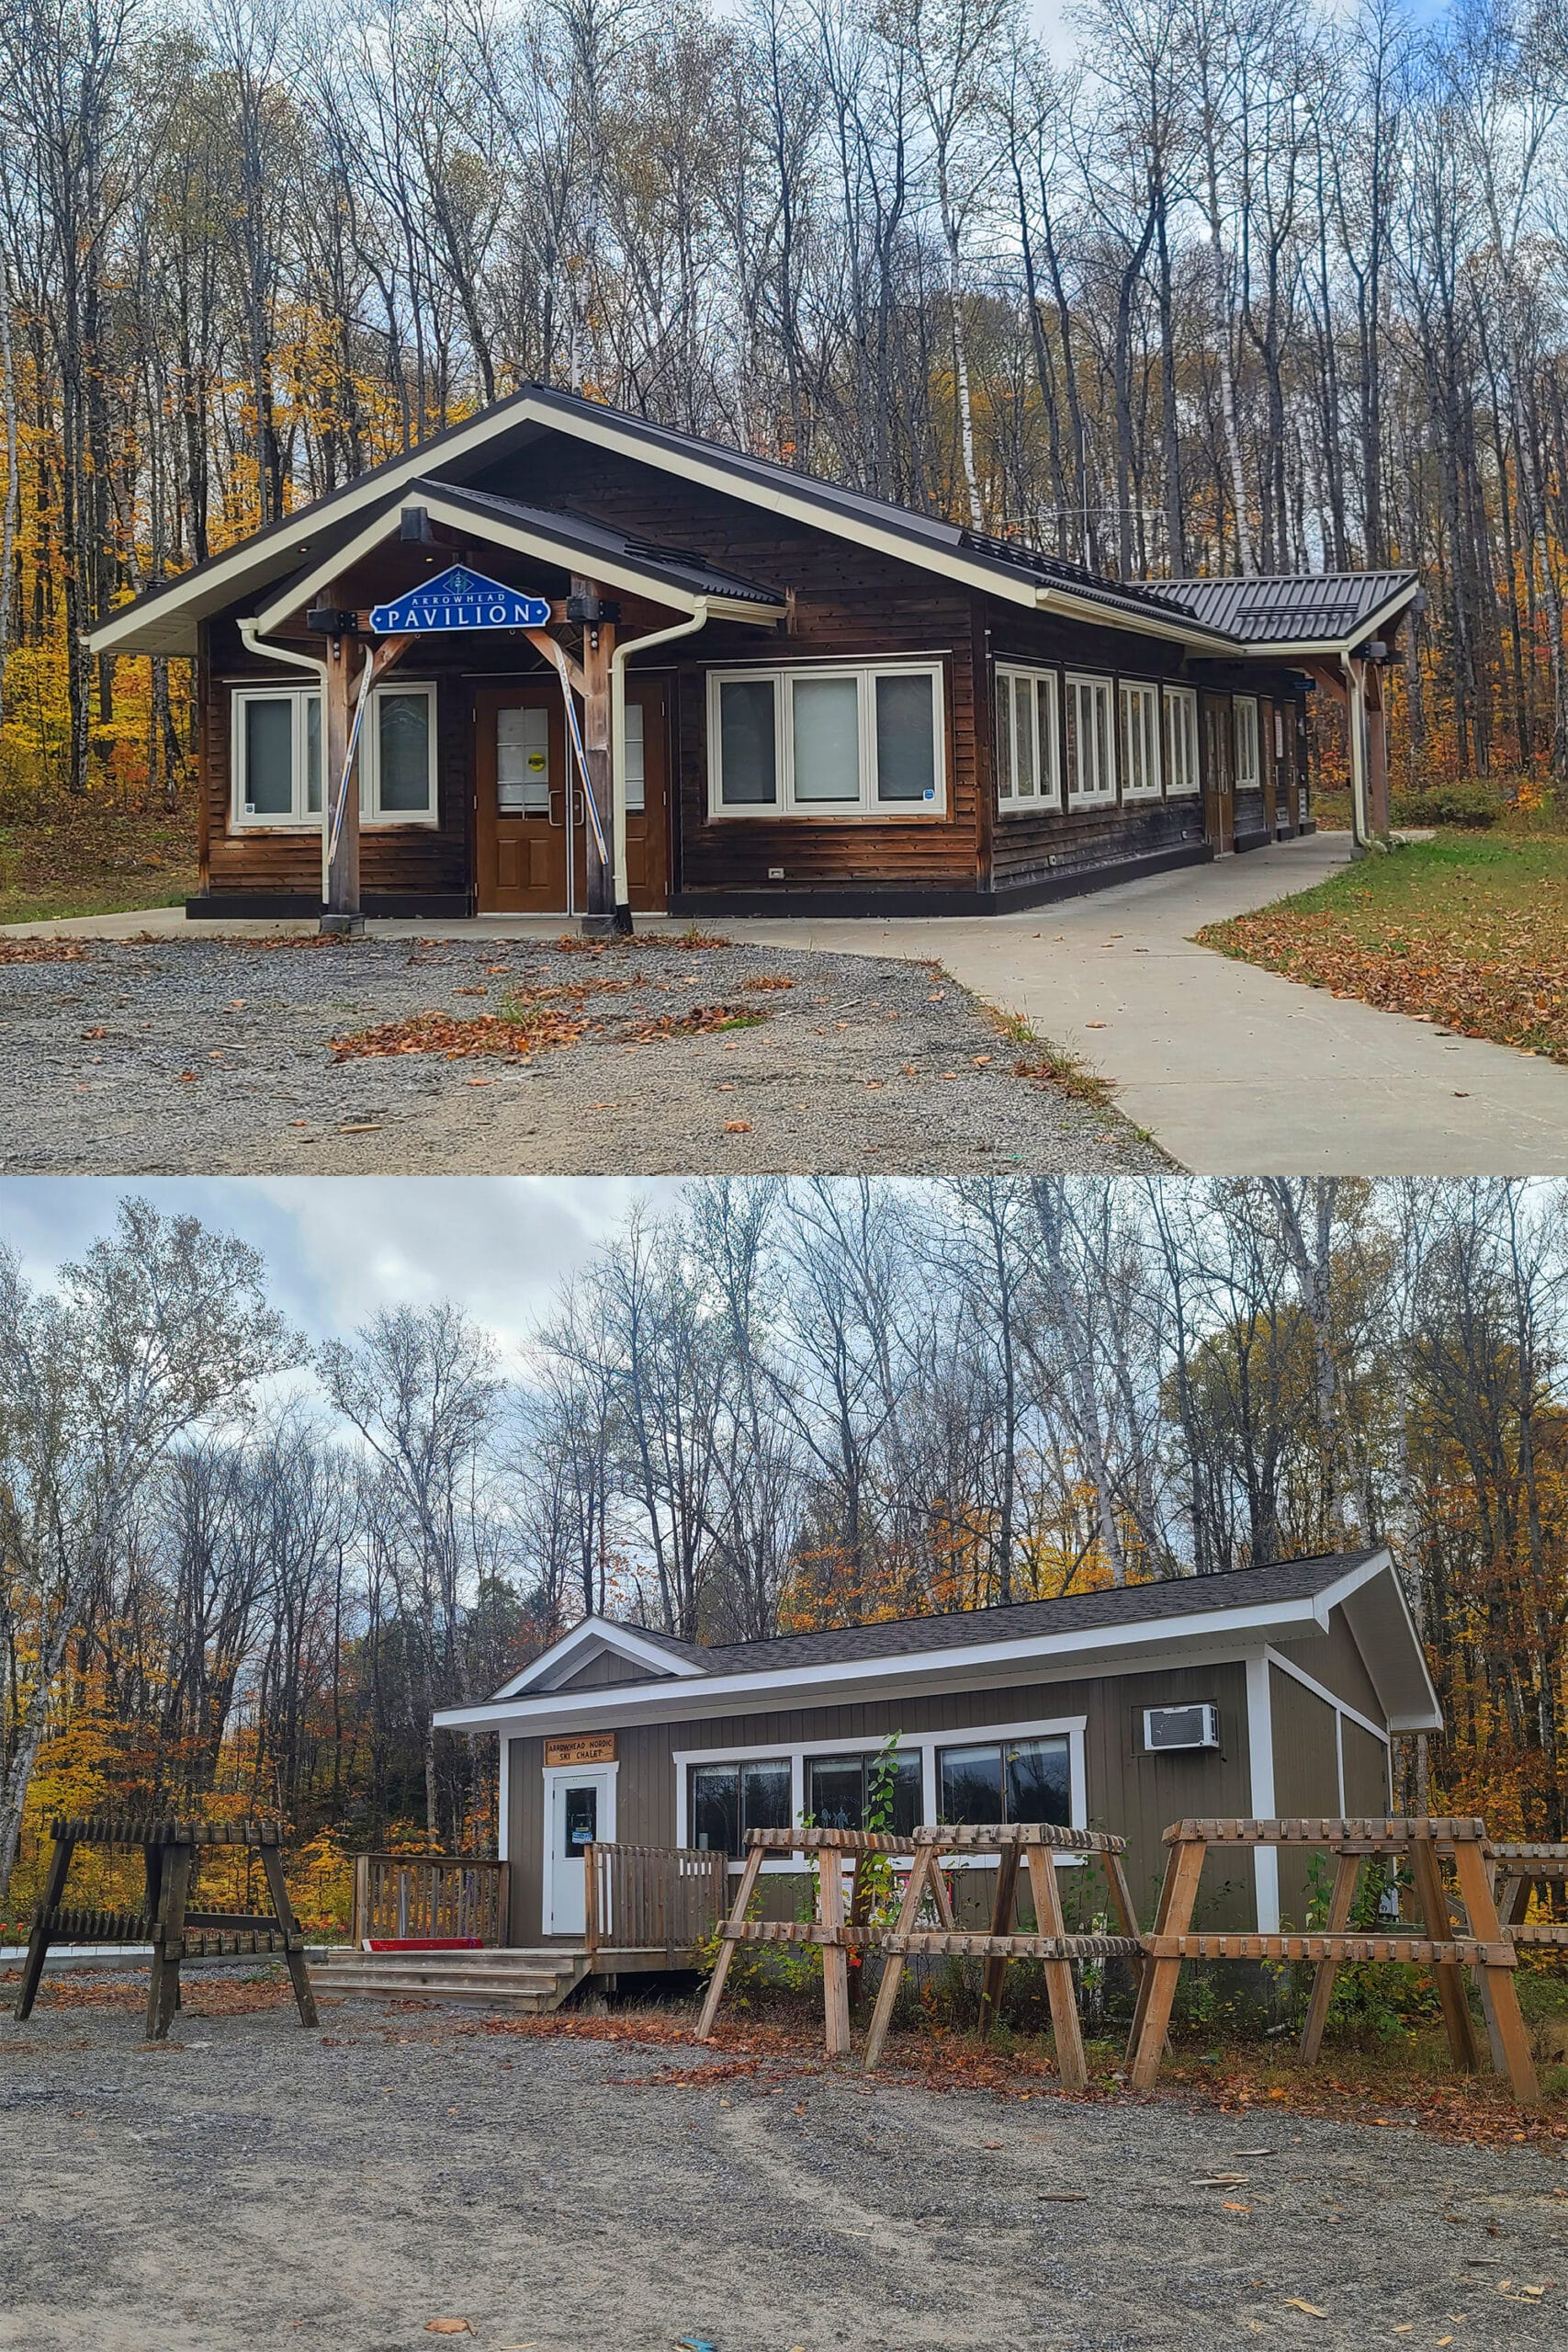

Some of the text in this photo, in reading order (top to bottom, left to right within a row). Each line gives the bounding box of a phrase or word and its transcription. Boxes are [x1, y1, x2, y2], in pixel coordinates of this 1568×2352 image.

[412, 594, 506, 605] ARROWHEAD
[388, 604, 530, 628] PAVILION
[549, 1740, 612, 1752] ARROWHEAD NORDIC
[577, 1749, 602, 1758] CHALET
